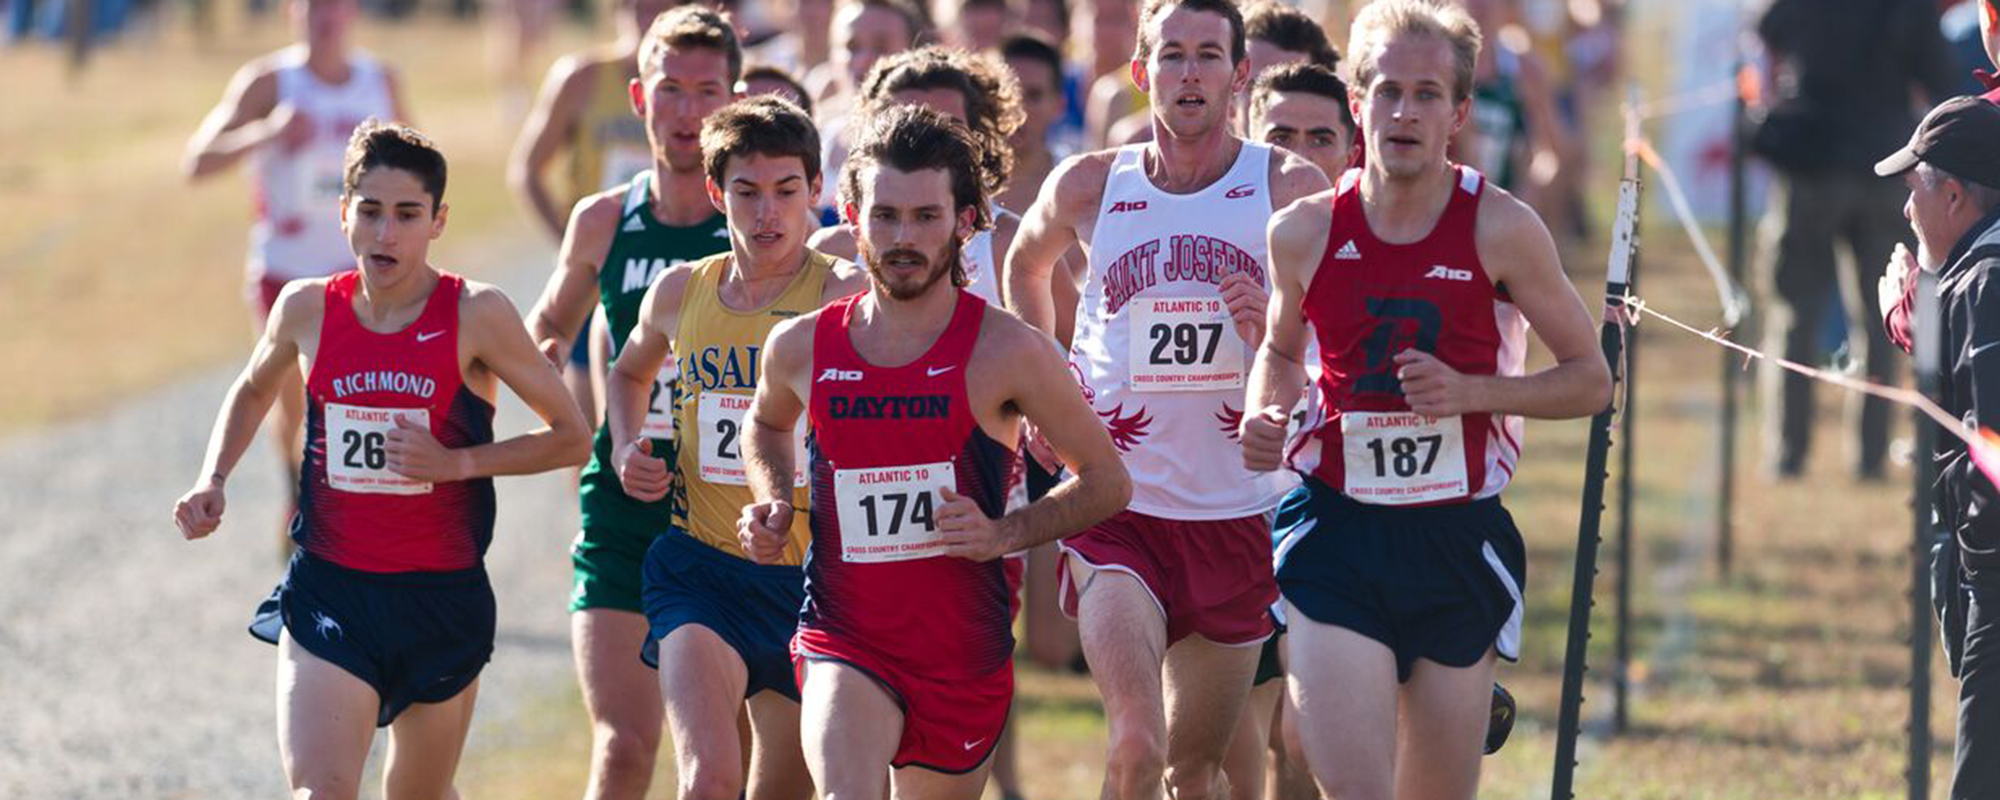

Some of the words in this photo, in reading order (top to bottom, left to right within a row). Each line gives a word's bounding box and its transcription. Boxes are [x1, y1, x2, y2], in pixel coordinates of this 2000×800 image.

[1108, 200, 1147, 214] A10
[622, 258, 688, 294] MA
[1103, 239, 1160, 316] SAINT
[1424, 265, 1473, 281] A10
[1152, 301, 1203, 313] ATLANTIC
[1206, 301, 1219, 312] 10
[1149, 323, 1223, 365] 297
[333, 370, 436, 398] RICHMOND
[817, 368, 863, 383] A10
[1156, 373, 1185, 383] COUNTRY
[345, 409, 390, 422] ATLANTIC
[829, 395, 949, 420] DAYTON
[1366, 415, 1419, 429] ATLANTIC
[342, 429, 386, 470] 26
[1367, 434, 1442, 478] 187
[859, 471, 911, 485] ATLANTIC
[915, 468, 929, 480] 10
[859, 491, 935, 536] 174
